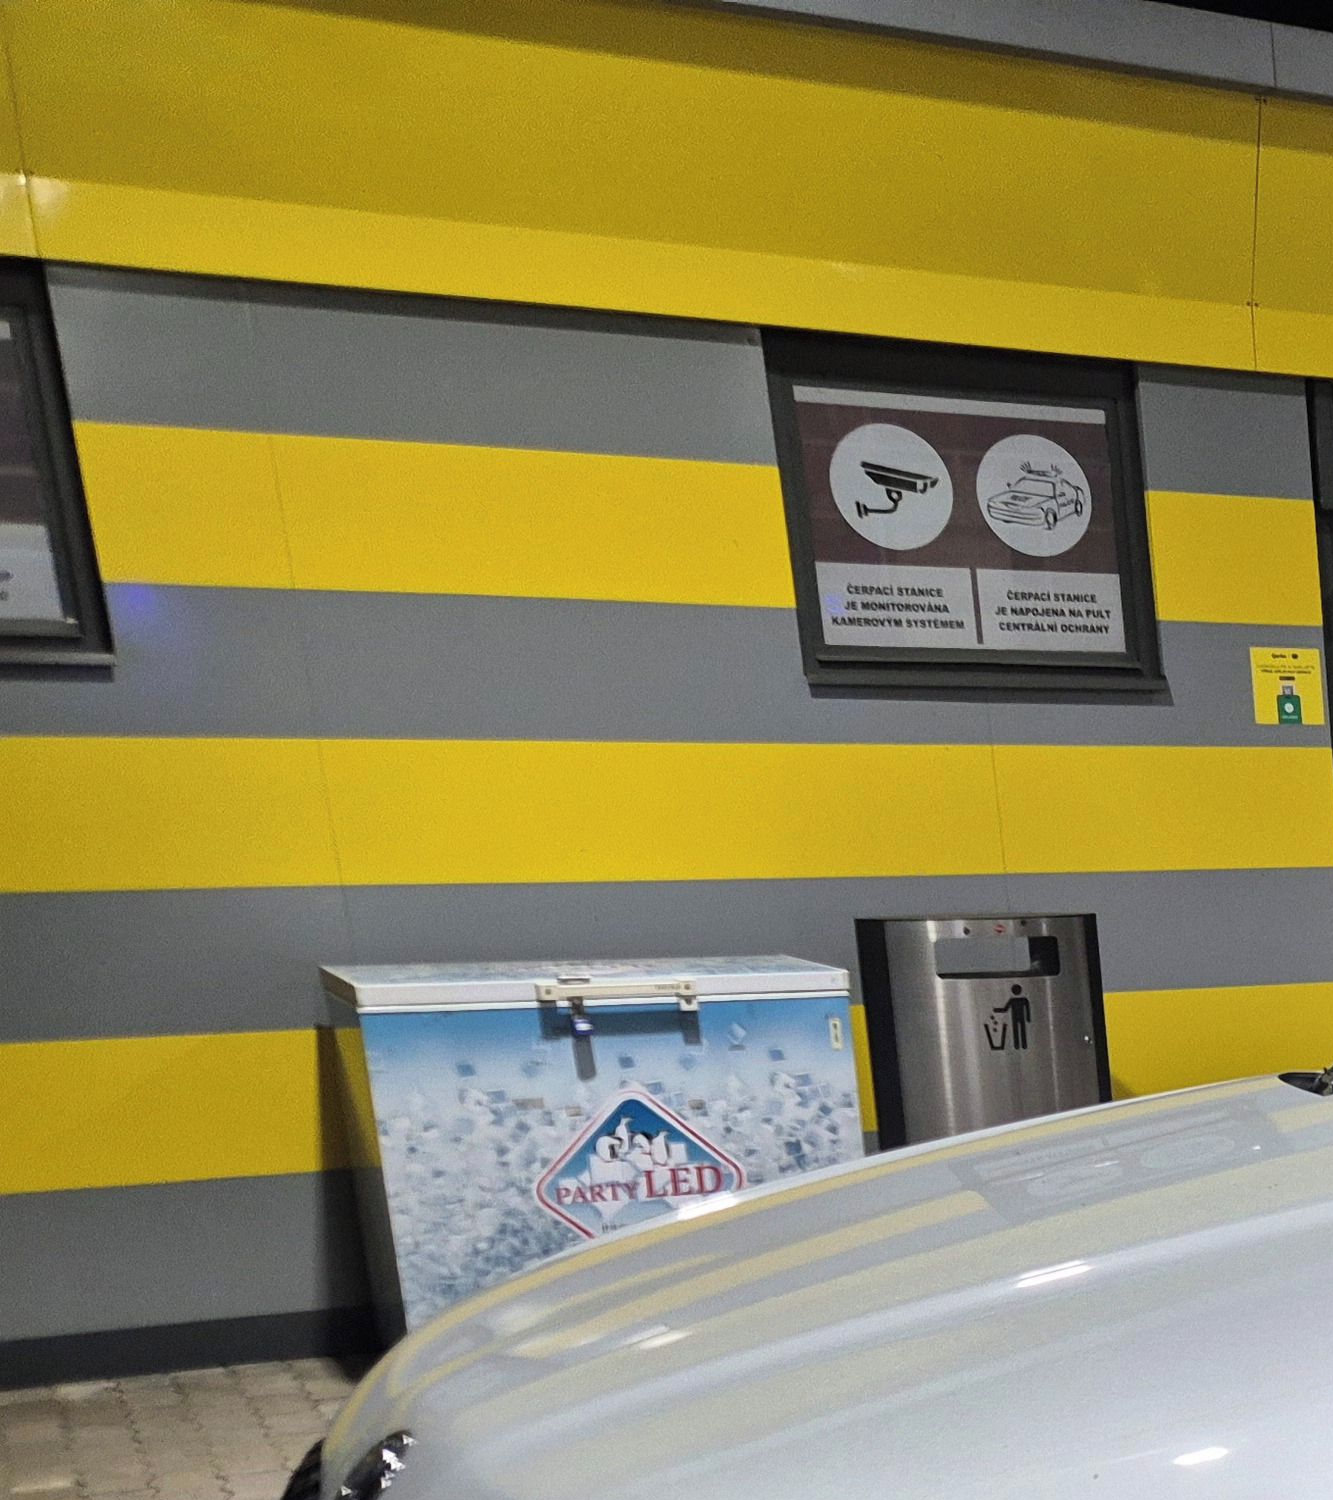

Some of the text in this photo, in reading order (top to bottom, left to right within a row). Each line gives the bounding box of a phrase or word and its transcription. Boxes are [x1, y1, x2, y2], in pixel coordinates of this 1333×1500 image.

[846, 582, 944, 598] ČERPACÍ STANICE
[1006, 590, 1097, 603] ČERPACÍ STANICE
[844, 601, 950, 613] JE MONITOROVÁNA
[995, 606, 1111, 619] JE NAPOJENA NA PULT
[831, 615, 966, 629] KAMEROVÝM SYSTÉMEM
[998, 620, 1058, 633] CENTRÁLNÍ
[556, 1165, 724, 1204] PARTY LED
